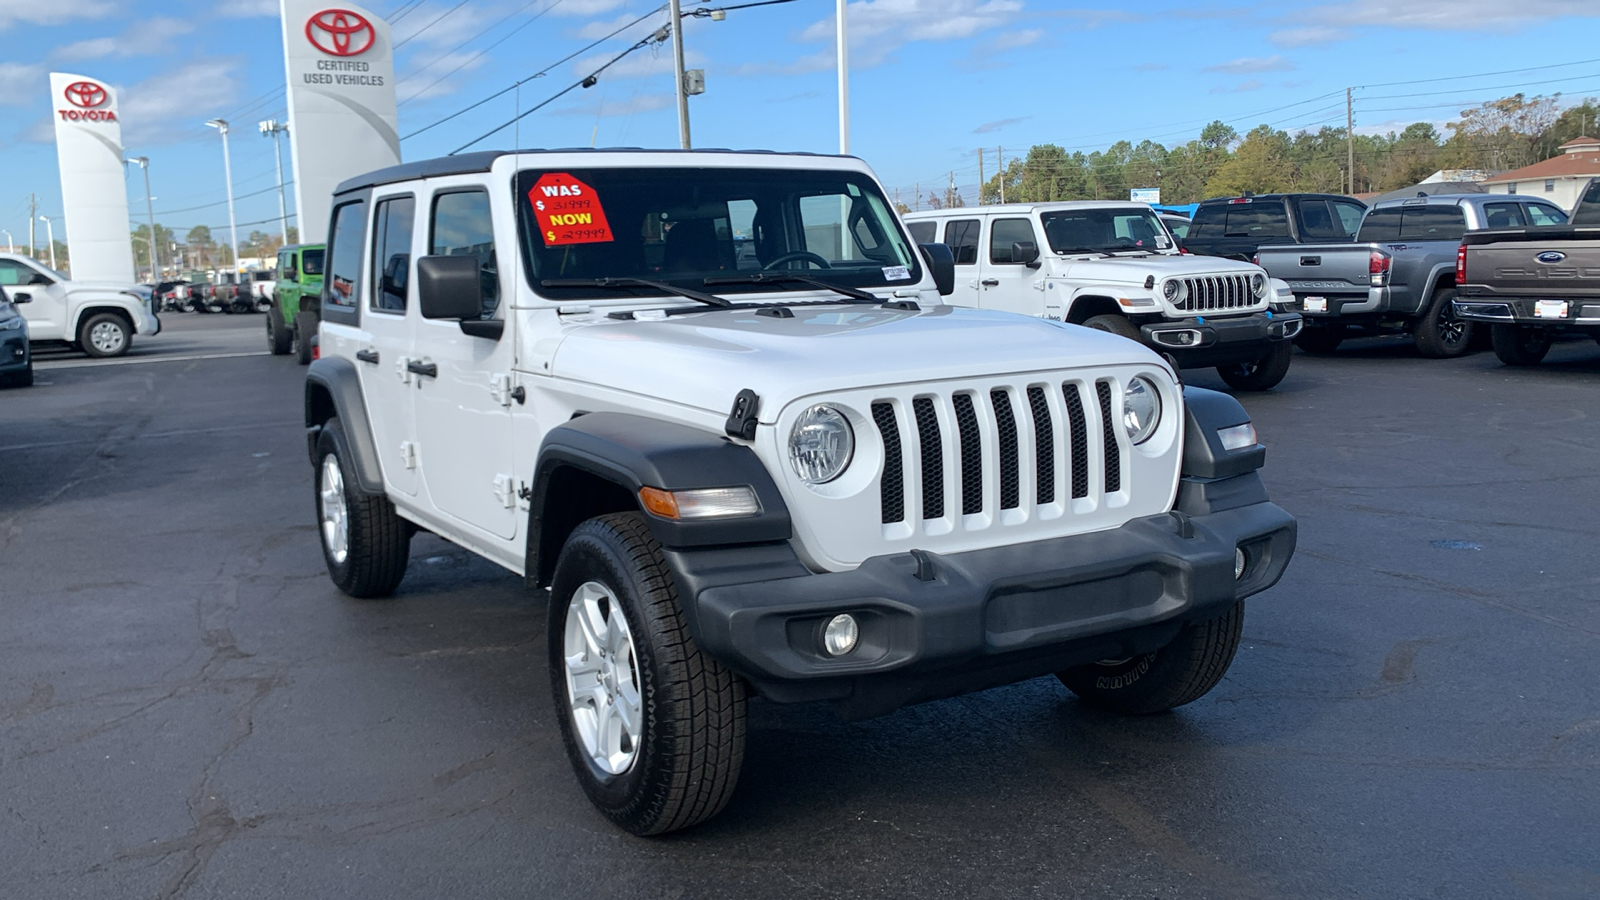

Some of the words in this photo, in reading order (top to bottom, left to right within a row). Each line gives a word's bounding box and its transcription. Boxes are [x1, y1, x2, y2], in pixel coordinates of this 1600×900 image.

[317, 60, 370, 72] CERTIFIED
[303, 73, 333, 84] USED
[334, 74, 385, 87] VEHICLES
[58, 109, 117, 121] TOYOTA
[540, 184, 582, 197] WAS
[535, 200, 546, 212] $
[549, 212, 593, 226] NOW
[546, 230, 557, 242] $
[562, 229, 606, 240] 29999
[1387, 244, 1408, 252] TRD
